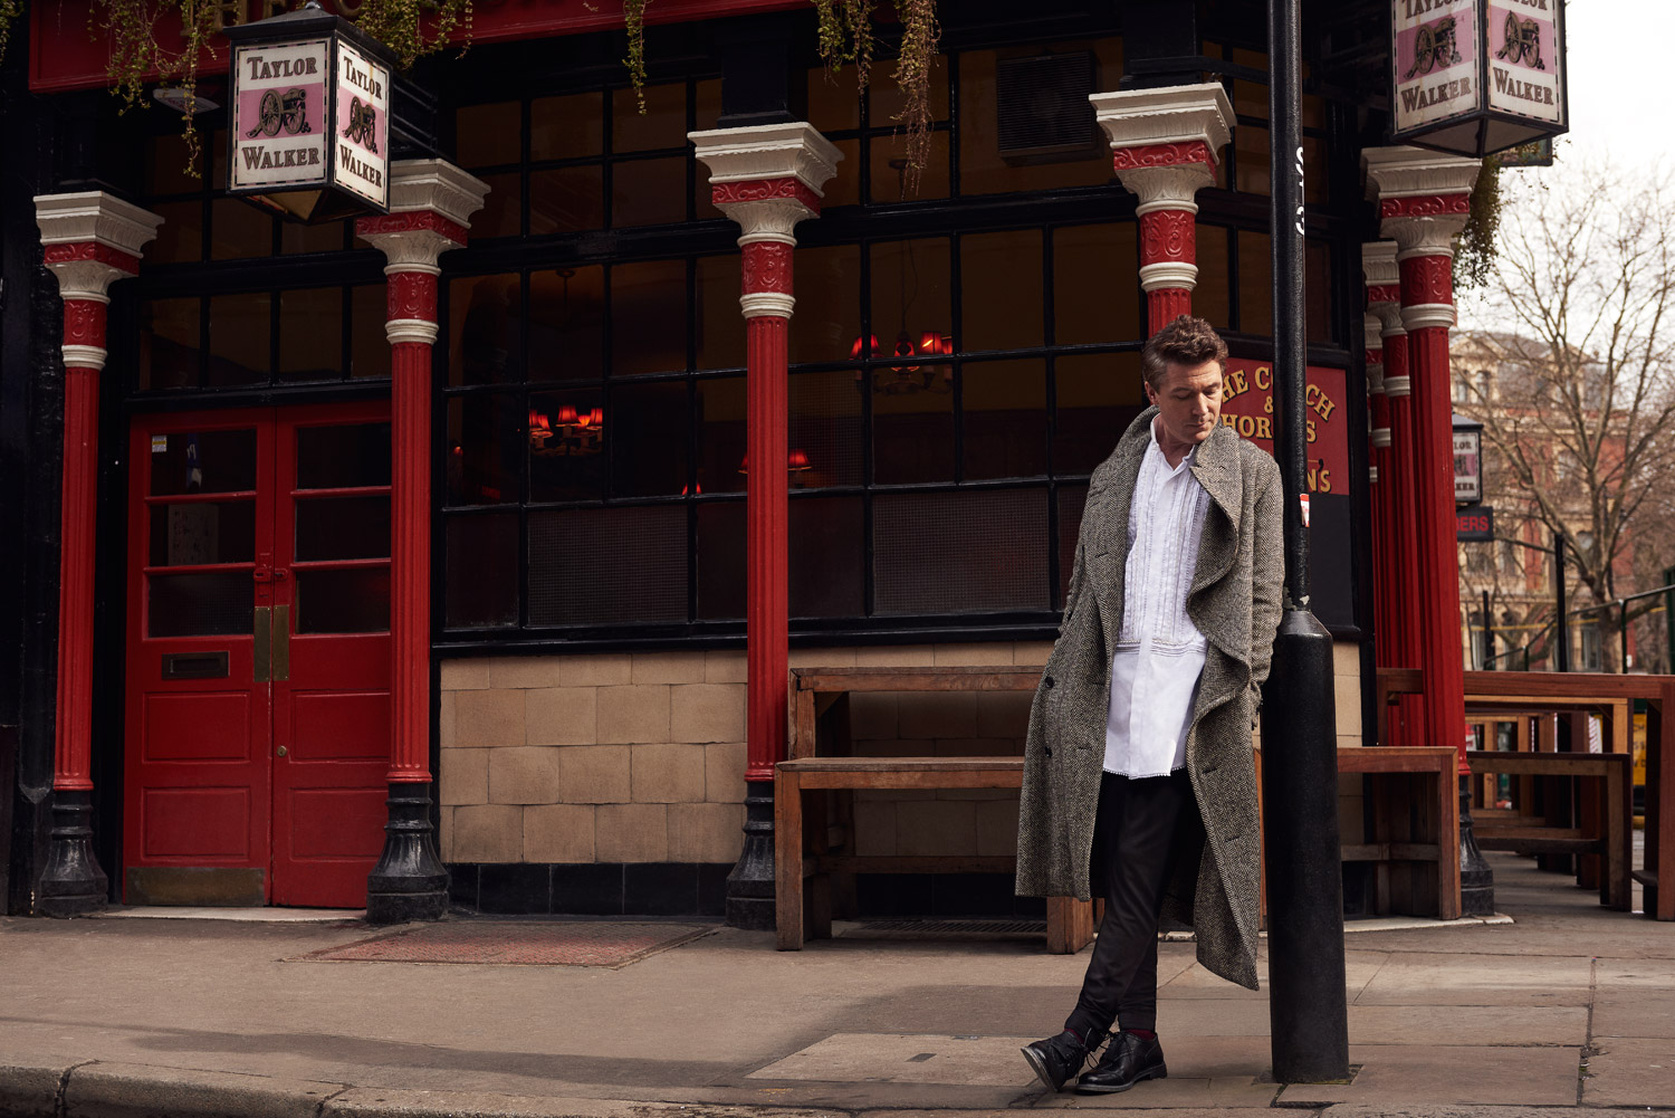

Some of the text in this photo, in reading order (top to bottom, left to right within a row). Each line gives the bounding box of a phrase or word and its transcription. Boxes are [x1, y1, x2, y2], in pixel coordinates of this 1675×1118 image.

[247, 56, 317, 80] TAYLOR
[344, 56, 382, 100] TAYLOR
[1401, 77, 1472, 114] WALKER
[1493, 67, 1554, 105] WALKER
[242, 145, 319, 170] WALKER
[340, 144, 382, 188] WALKER
[1222, 366, 1335, 422] HE CCH
[1221, 413, 1317, 443] HORS
[1307, 460, 1332, 492] N'S
[1456, 482, 1475, 491] KER
